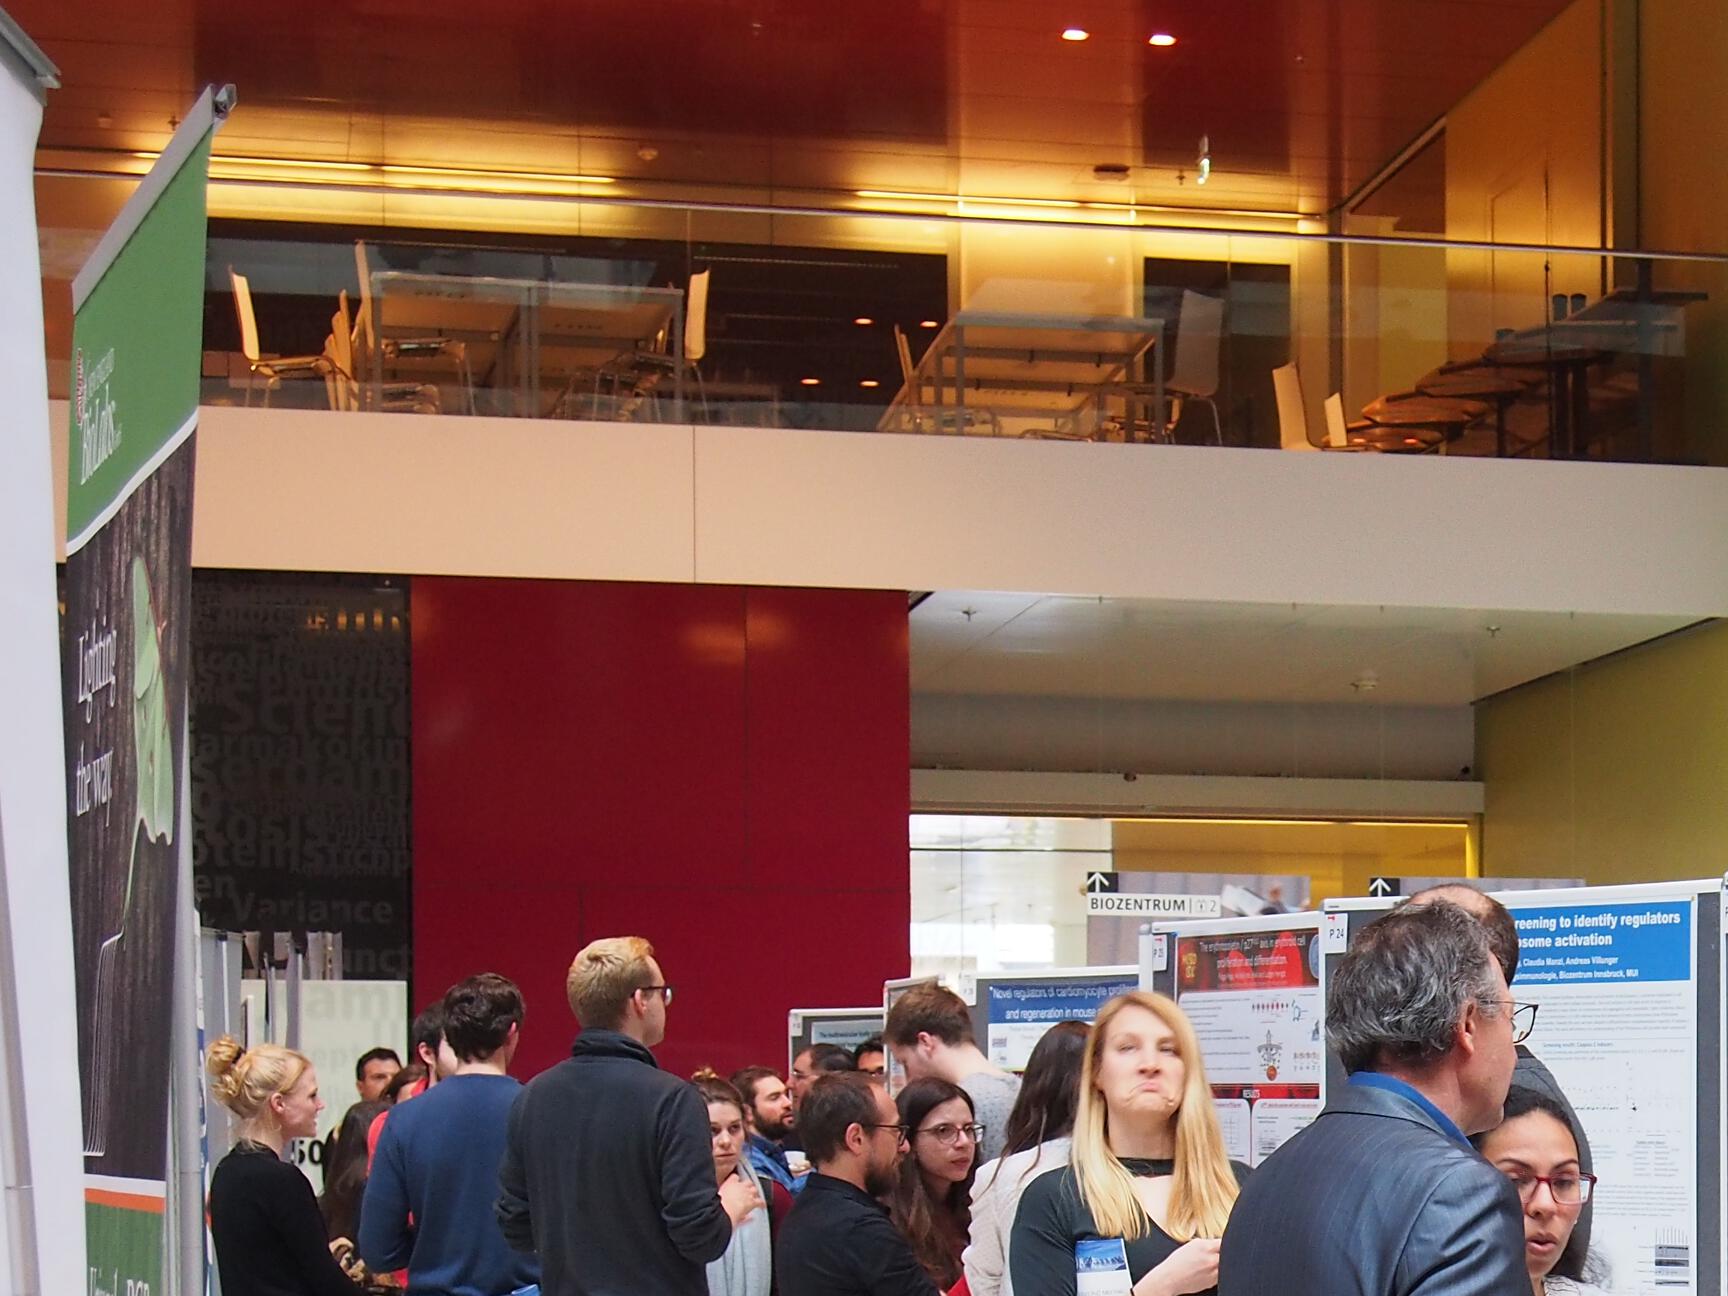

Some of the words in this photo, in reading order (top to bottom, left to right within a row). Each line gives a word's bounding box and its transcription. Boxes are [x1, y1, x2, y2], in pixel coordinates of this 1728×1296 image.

[77, 741, 91, 816] the
[1091, 898, 1185, 912] BIOZENTRUM
[1210, 901, 1217, 913] 2
[1559, 917, 1571, 928] to
[1574, 914, 1618, 929] identify
[1620, 912, 1680, 928] regulators
[1330, 928, 1335, 939] P
[1336, 928, 1345, 939] 24
[1554, 933, 1612, 948] activation
